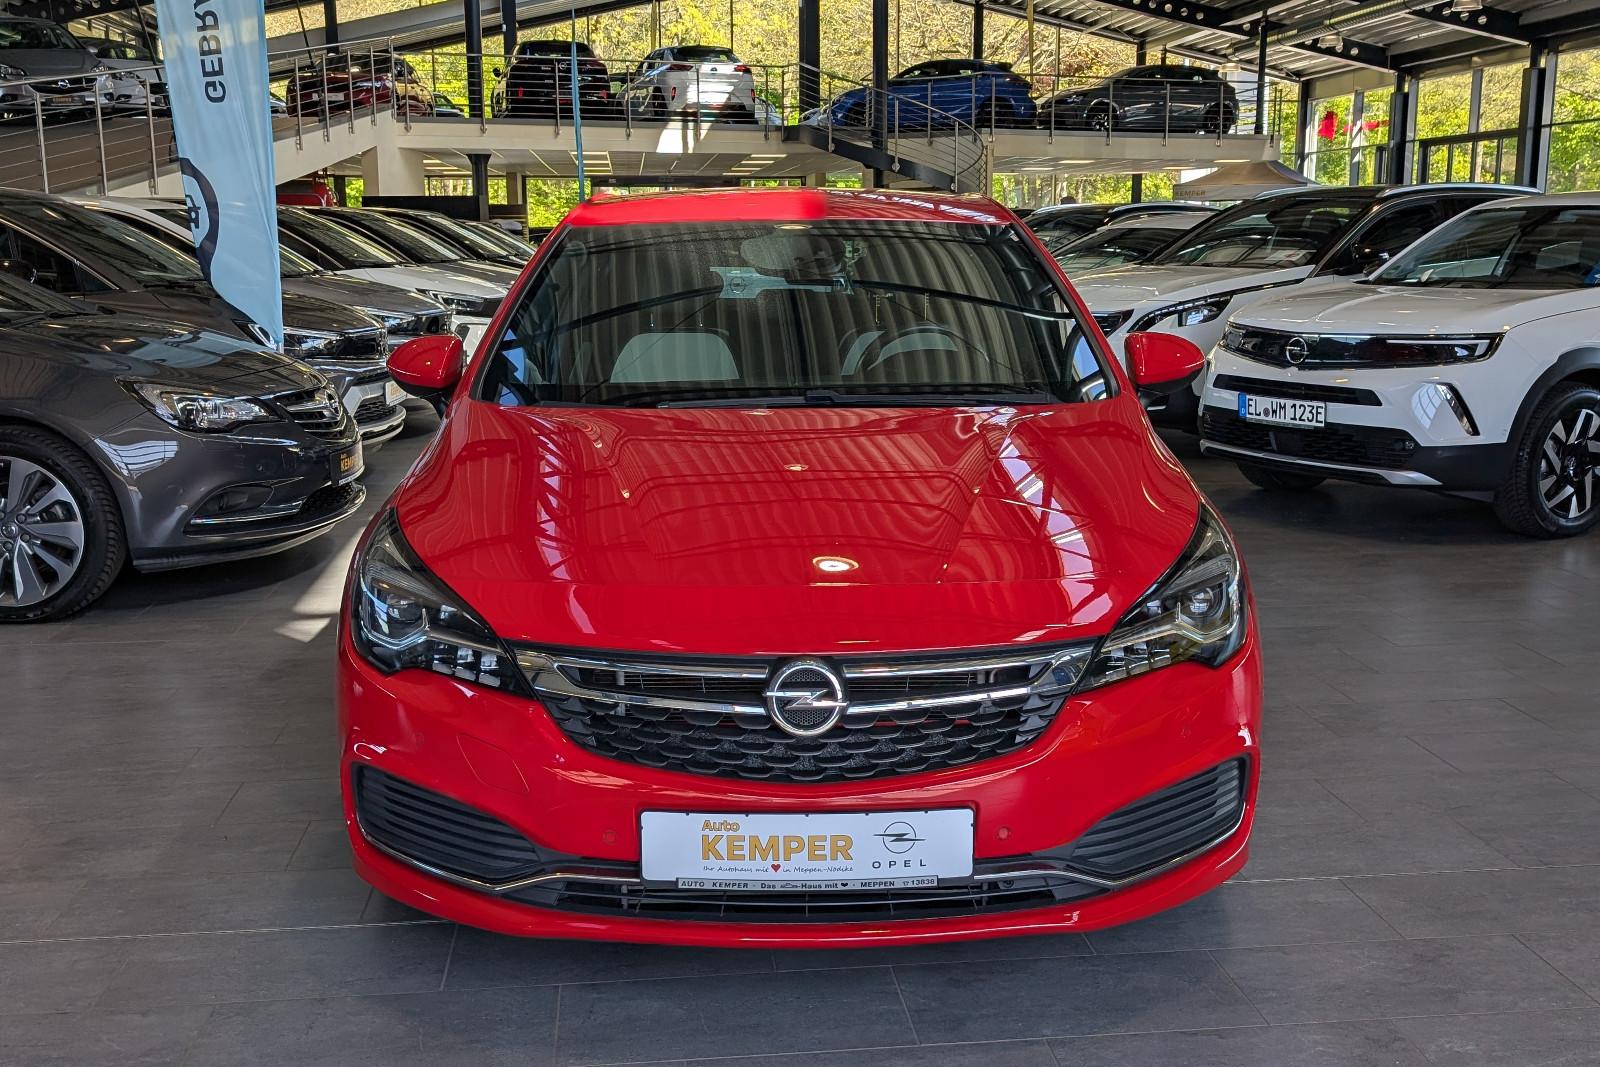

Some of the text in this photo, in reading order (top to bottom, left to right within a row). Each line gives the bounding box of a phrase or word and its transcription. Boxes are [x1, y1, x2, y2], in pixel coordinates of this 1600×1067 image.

[1247, 398, 1324, 424] EL WM 123E
[702, 819, 740, 832] Auto
[702, 834, 854, 861] KEMPER
[717, 865, 752, 873] Autohaus
[872, 859, 927, 869] OPEL
[680, 880, 705, 888] AUTO
[712, 881, 749, 889] KEMPER
[860, 880, 895, 888] MEPPEN
